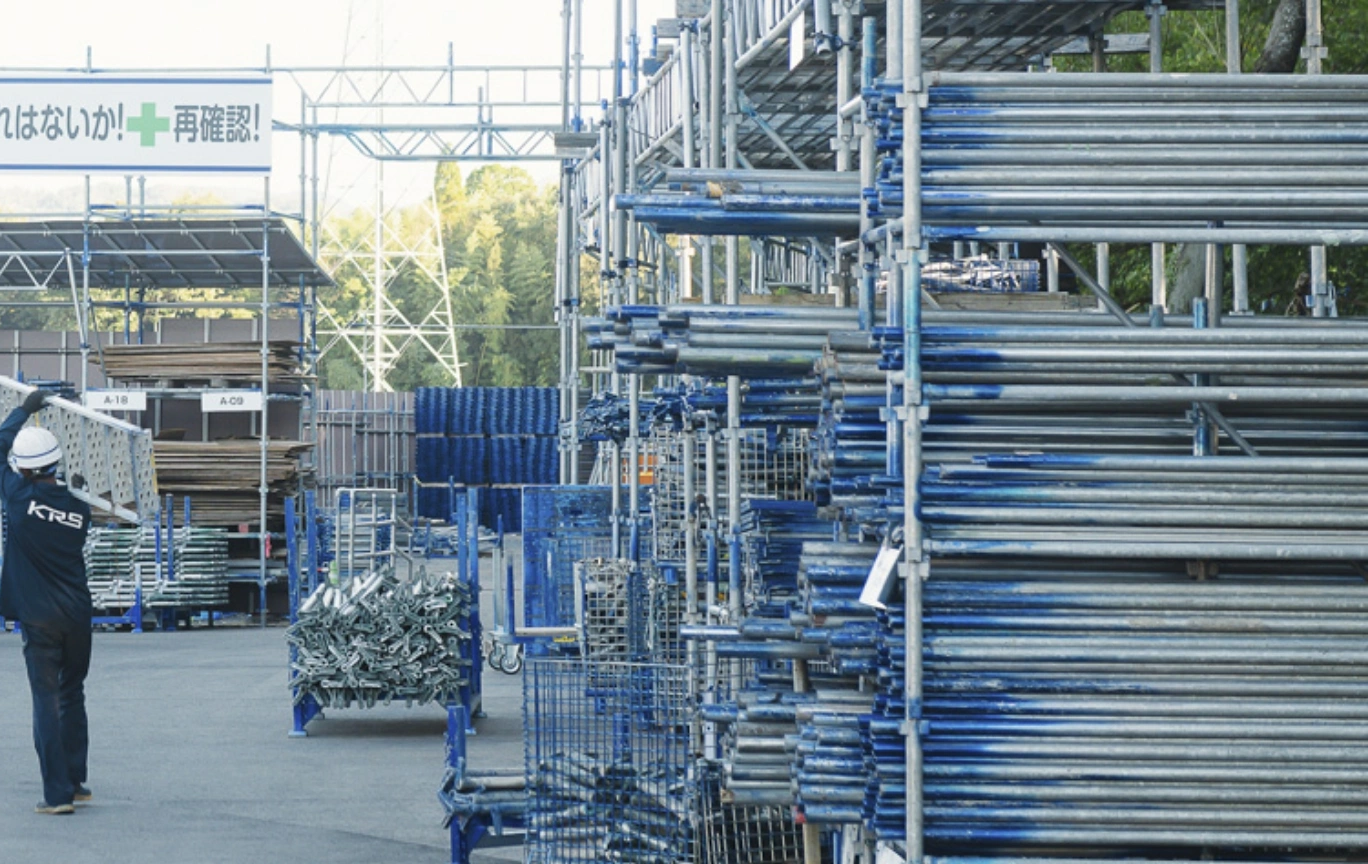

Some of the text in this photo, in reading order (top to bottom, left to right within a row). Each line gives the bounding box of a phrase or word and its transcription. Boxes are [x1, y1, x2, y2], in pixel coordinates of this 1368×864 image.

[173, 103, 261, 143] 再確認!
[27, 500, 83, 530] KRS
